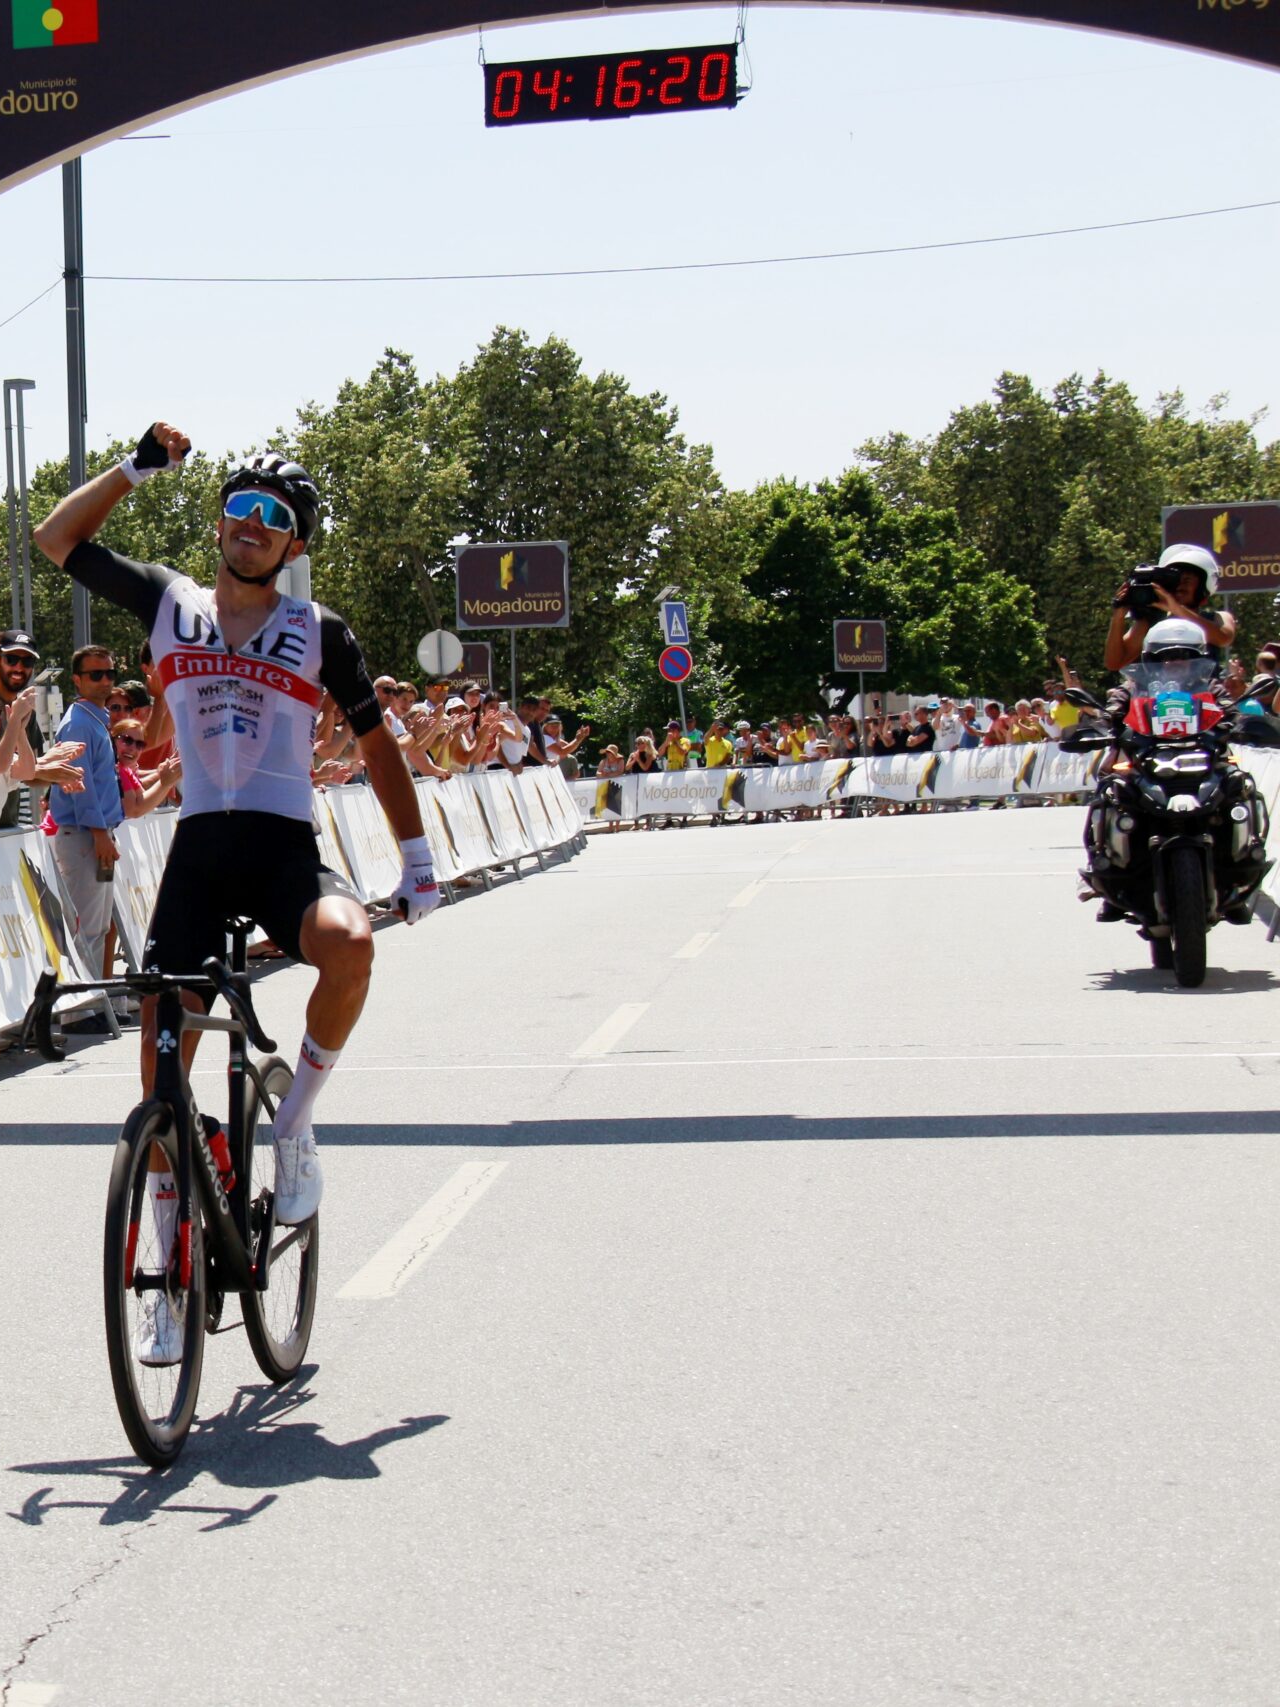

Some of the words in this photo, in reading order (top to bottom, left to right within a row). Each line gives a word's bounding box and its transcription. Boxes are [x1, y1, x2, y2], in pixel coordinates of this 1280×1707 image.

[65, 76, 77, 87] de
[492, 52, 730, 118] 04:16:20
[1218, 561, 1280, 578] adouro
[463, 597, 562, 617] Mogadouro
[173, 655, 293, 692] Emirates
[643, 783, 718, 802] Mogadouro
[190, 1096, 230, 1215] COLNAGO
